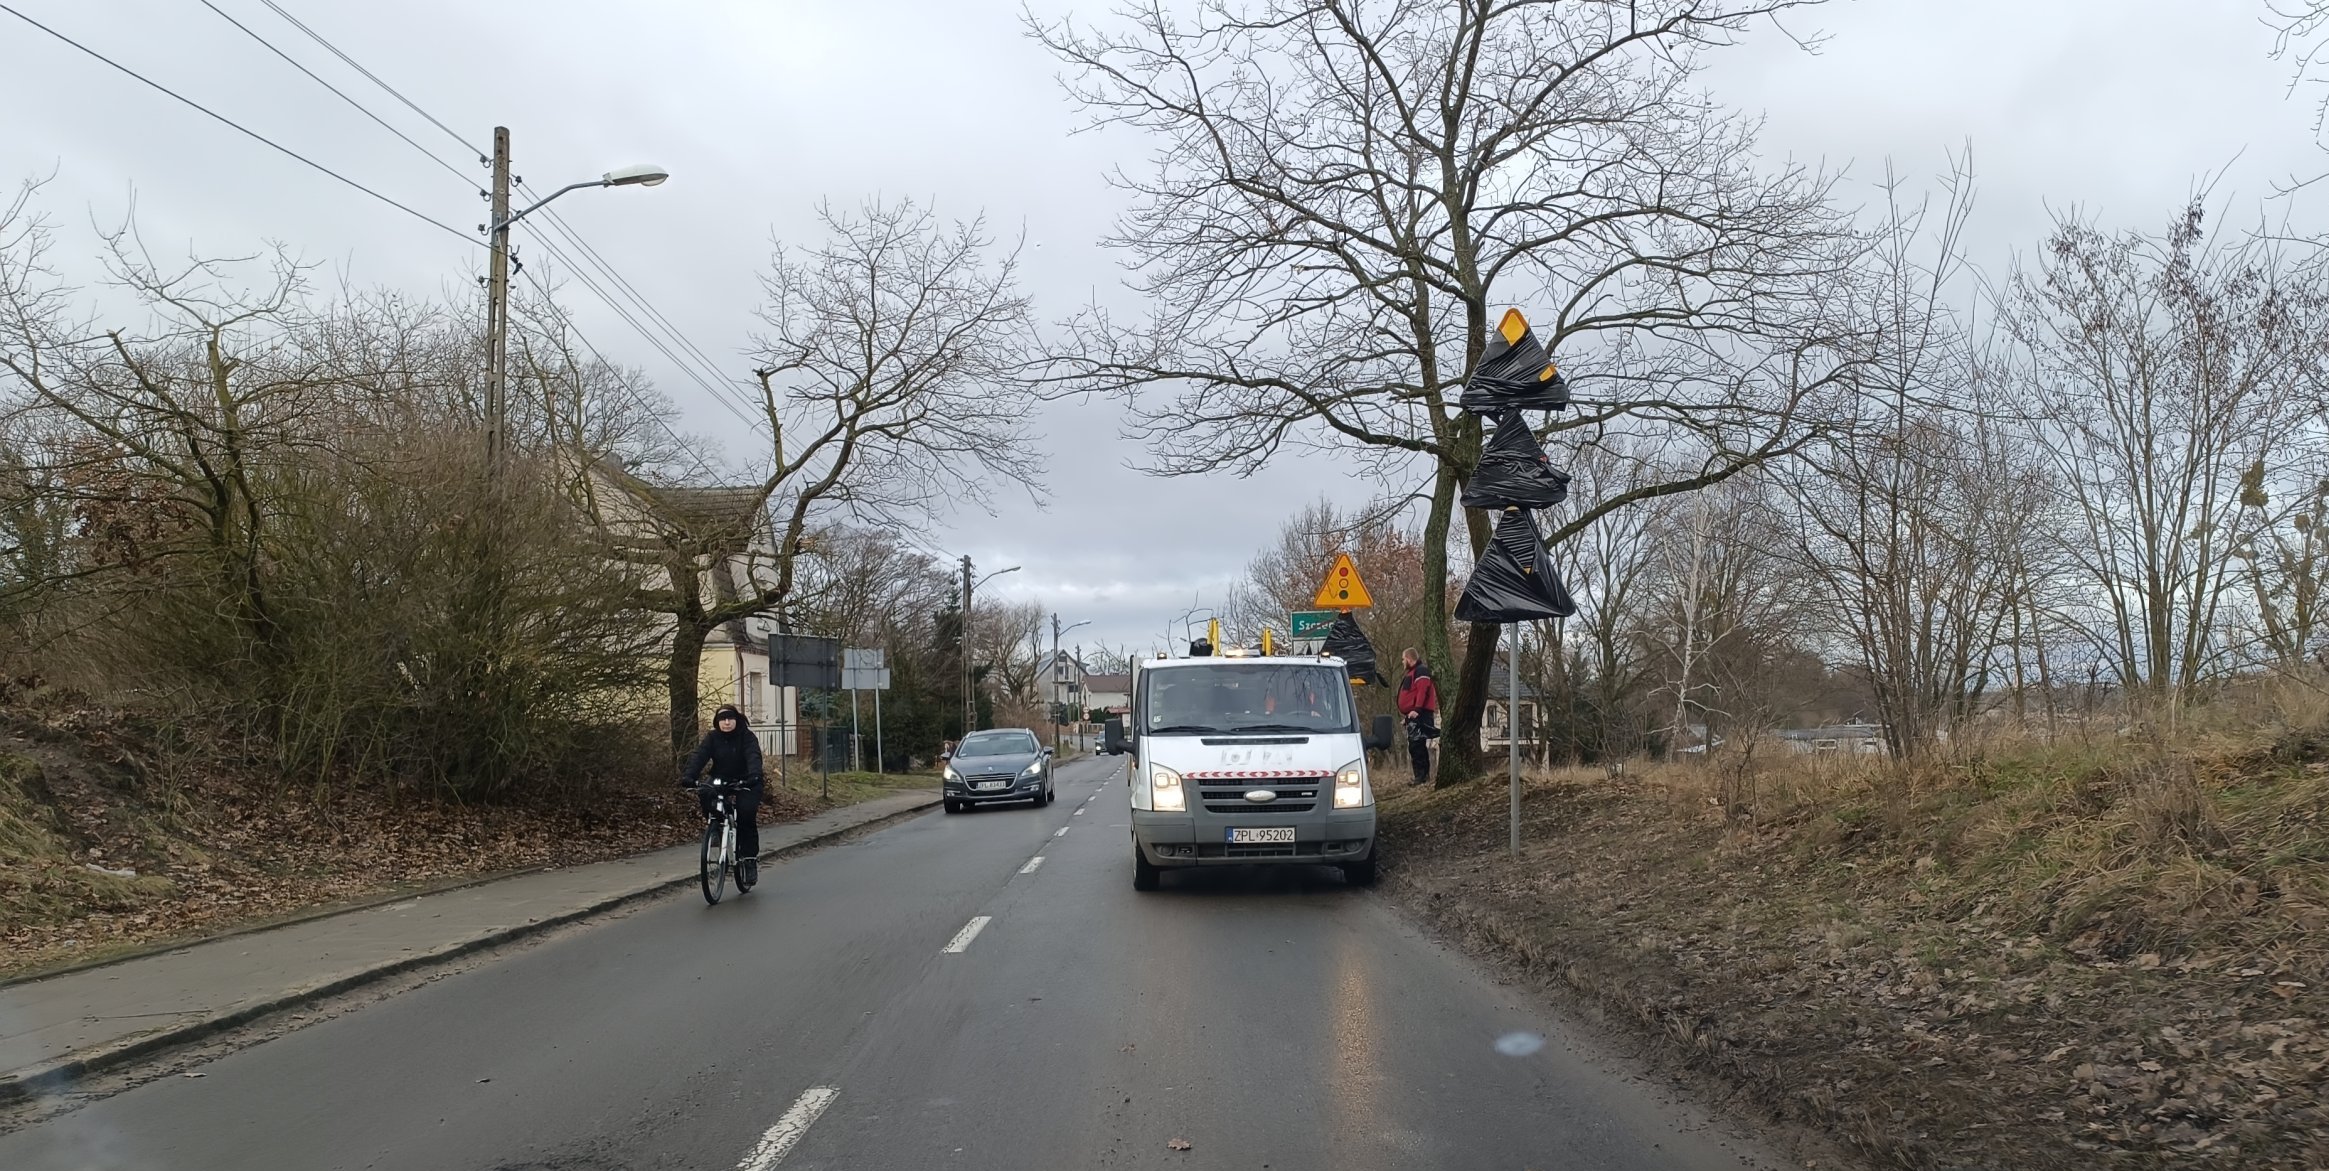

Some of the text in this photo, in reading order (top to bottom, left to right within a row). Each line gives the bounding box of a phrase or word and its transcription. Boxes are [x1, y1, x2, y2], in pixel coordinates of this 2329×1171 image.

[1298, 620, 1335, 631] Szczec
[1234, 830, 1255, 842] ZPL
[1259, 829, 1294, 841] 95202
